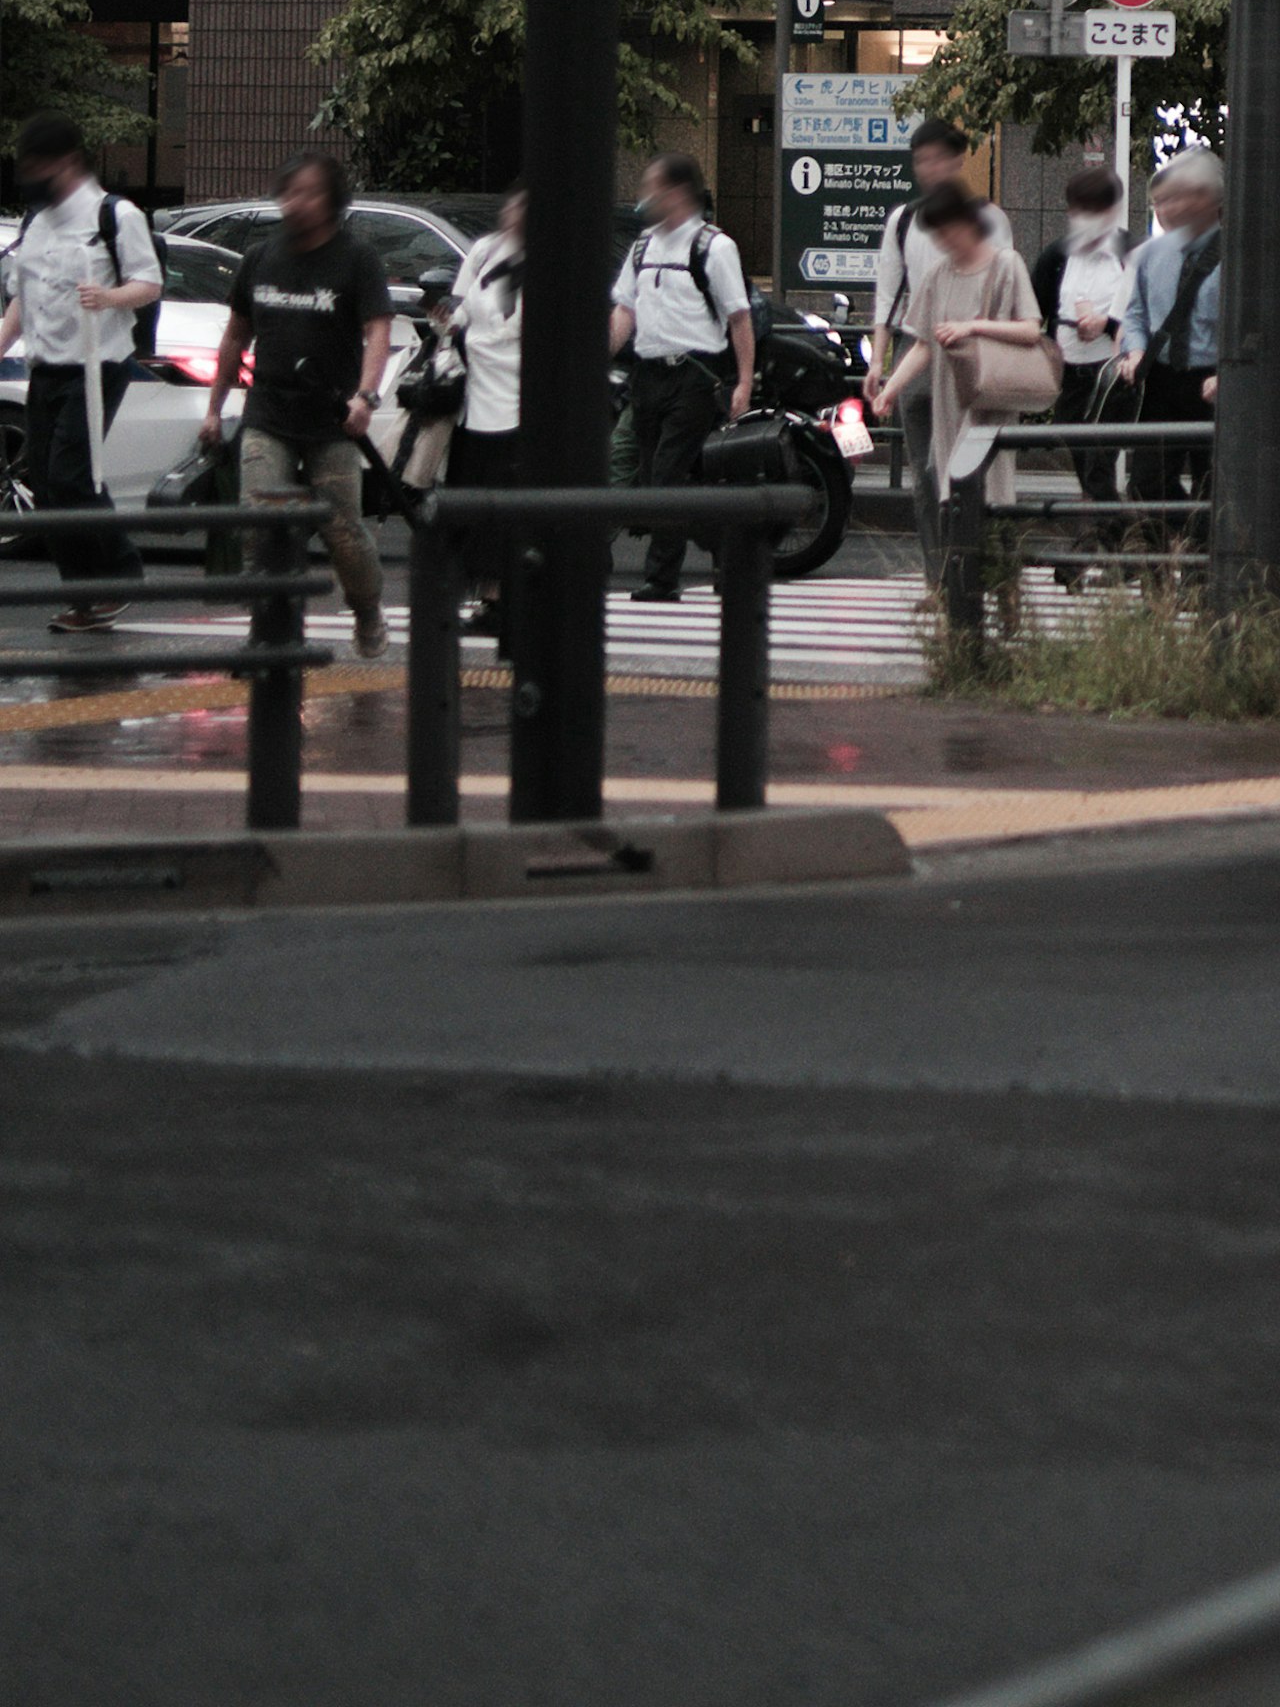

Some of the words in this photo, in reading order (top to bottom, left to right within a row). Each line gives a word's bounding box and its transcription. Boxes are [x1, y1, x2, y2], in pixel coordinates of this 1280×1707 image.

[1091, 21, 1171, 47] ここまで
[835, 95, 879, 106] Toranomon
[823, 163, 903, 177] 港区エリアマップ
[824, 178, 853, 189] Minato
[853, 178, 871, 191] City
[872, 179, 892, 190] Area
[893, 179, 913, 192] Map
[823, 232, 851, 242] Minato
[852, 231, 870, 244] City
[836, 254, 881, 268] 環二通
